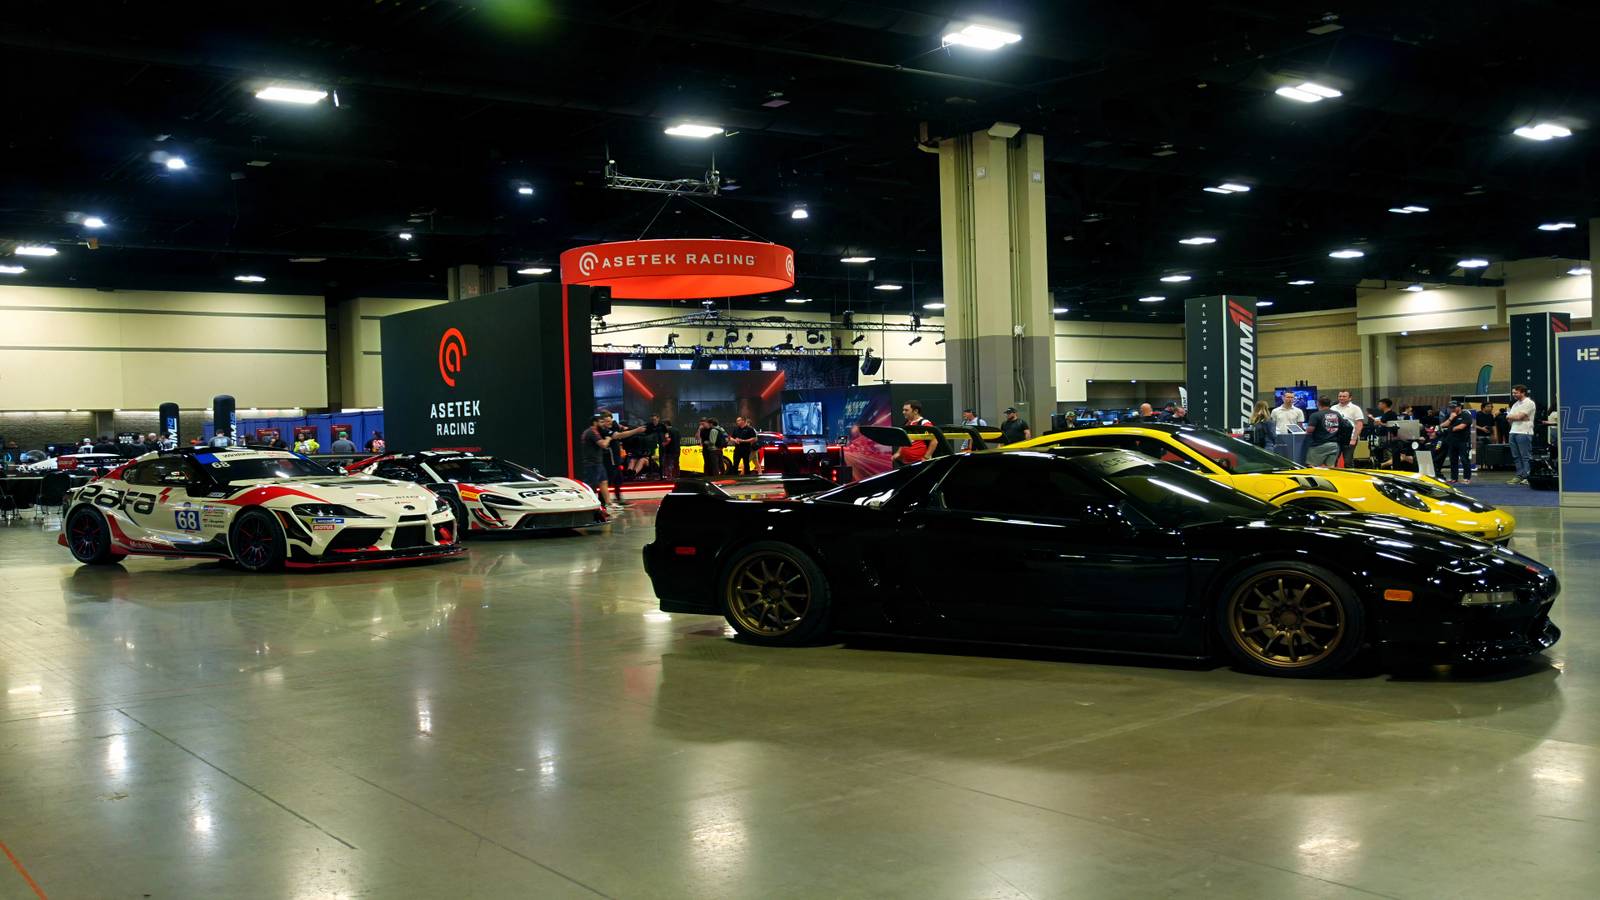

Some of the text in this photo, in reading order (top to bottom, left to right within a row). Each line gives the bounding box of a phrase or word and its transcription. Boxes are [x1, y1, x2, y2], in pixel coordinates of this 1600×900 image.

[601, 253, 756, 269] ASETEK RACING
[430, 400, 481, 419] ASETEK
[436, 422, 475, 436] RACING
[211, 461, 231, 469] 68
[177, 511, 197, 530] 68
